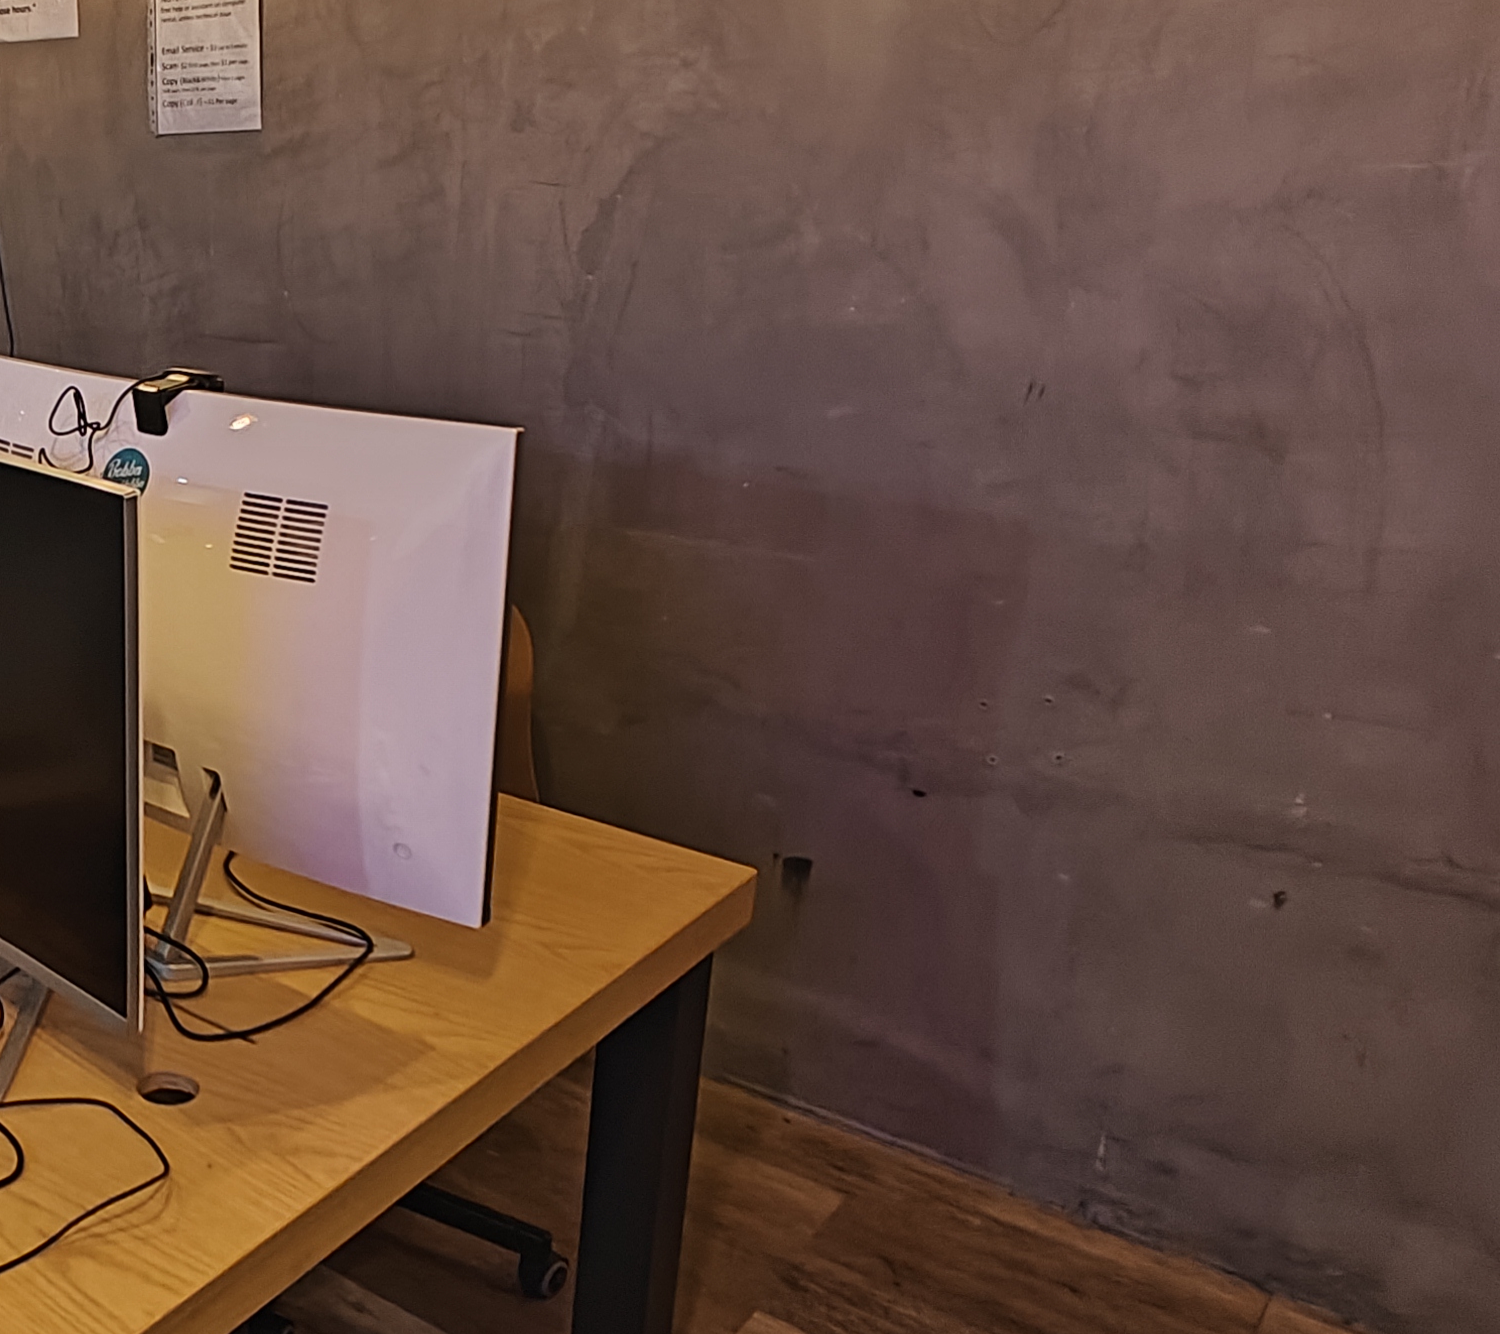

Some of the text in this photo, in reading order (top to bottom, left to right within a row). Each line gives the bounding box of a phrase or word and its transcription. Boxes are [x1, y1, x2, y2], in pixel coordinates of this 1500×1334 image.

[162, 45, 179, 55] Email
[181, 44, 204, 54] Service
[162, 77, 178, 86] Copy
[162, 99, 179, 109] Copy
